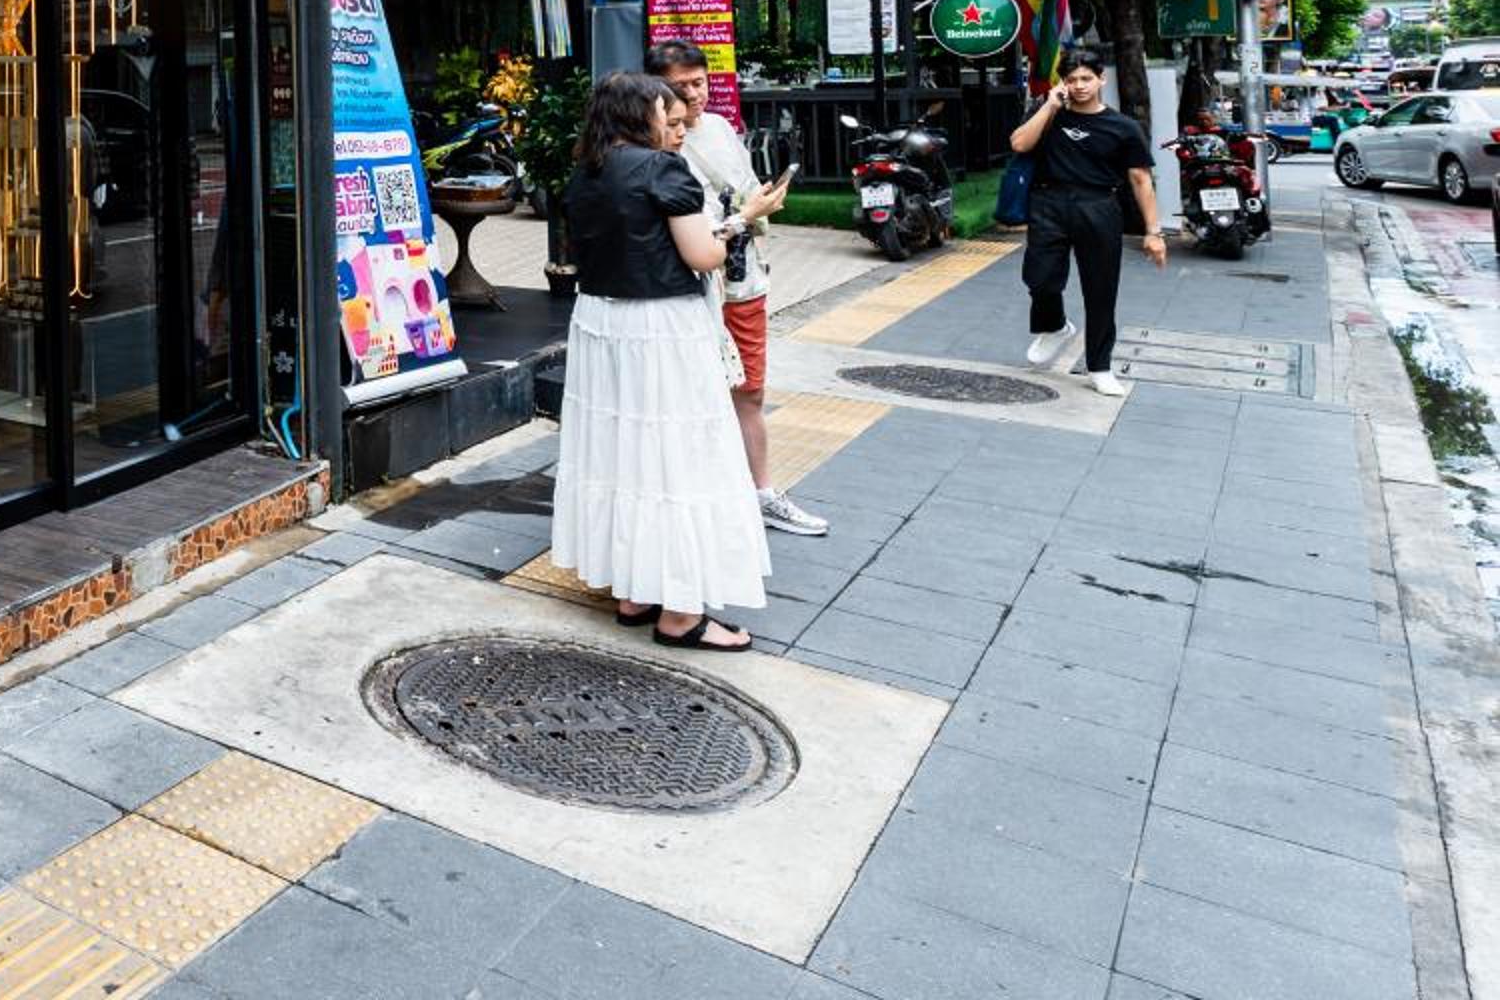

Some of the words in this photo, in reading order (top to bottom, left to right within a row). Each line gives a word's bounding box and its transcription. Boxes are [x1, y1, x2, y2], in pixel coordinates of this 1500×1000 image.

[946, 26, 1002, 40] Heineken
[333, 169, 369, 193] resh
[335, 194, 377, 217] abric
